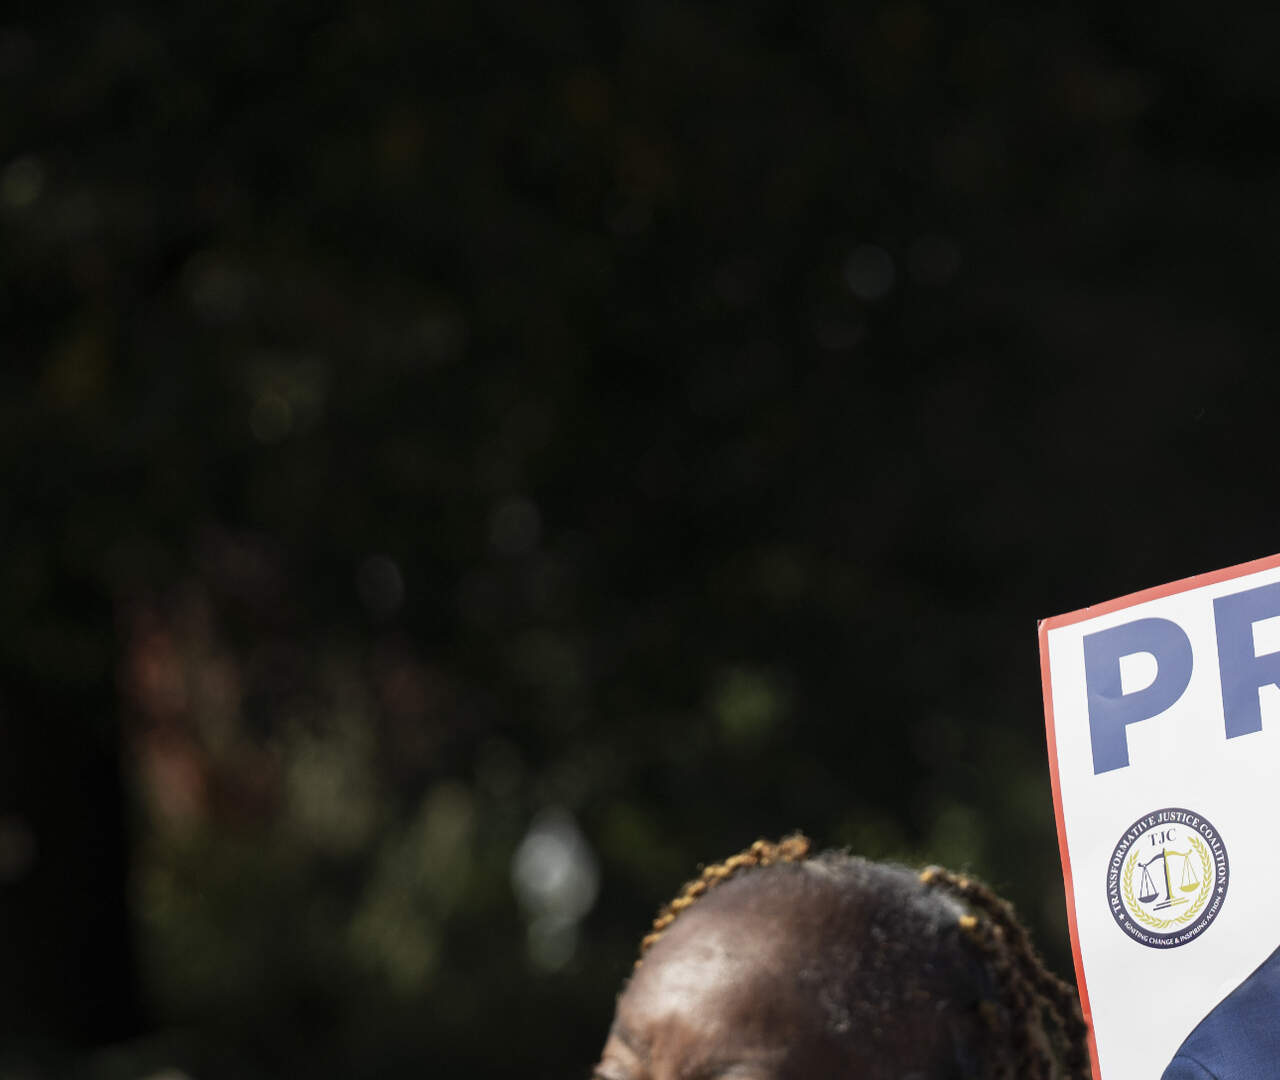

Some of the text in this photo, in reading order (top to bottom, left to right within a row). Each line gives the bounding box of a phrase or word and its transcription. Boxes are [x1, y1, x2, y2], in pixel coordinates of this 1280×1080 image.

[1109, 811, 1227, 914] TRANSFORMATIVE JUSTICE COALITION
[1148, 828, 1177, 846] TJC
[1148, 935, 1174, 946] CHANGE
[1179, 920, 1208, 942] INSPIRING
[1206, 895, 1222, 921] ACTION
